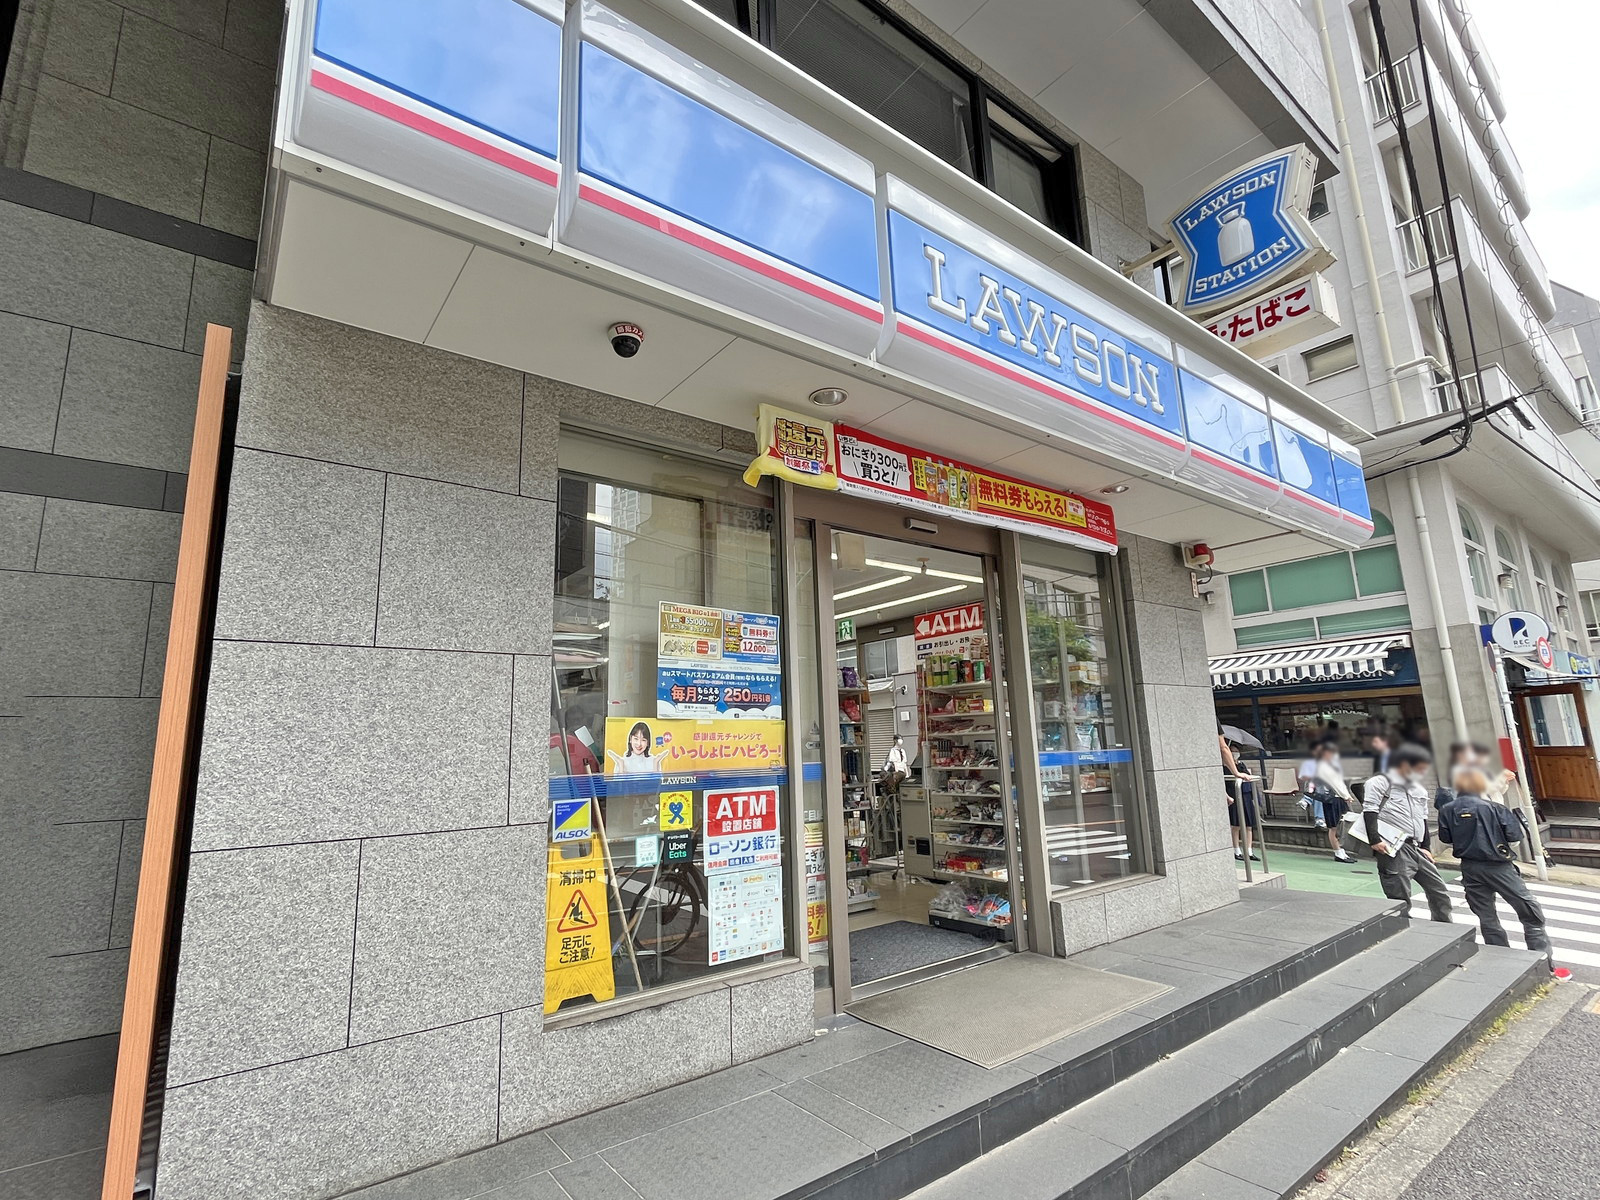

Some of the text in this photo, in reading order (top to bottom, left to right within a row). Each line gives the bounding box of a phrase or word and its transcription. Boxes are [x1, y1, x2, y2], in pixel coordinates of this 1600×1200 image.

[1183, 169, 1278, 232] LAWSON
[1194, 235, 1291, 294] STATION
[923, 243, 1165, 415] LAWSON
[979, 477, 1068, 518] 無料券もらえる!
[930, 606, 980, 636] ATM
[1513, 638, 1530, 646] REC
[671, 684, 697, 703] 毎月
[671, 743, 783, 759] いっしょにハピろー!
[661, 776, 697, 785] LAWSON
[715, 794, 767, 820] ATM
[555, 829, 589, 840] ALSOK
[668, 842, 687, 851] Uber
[668, 850, 687, 859] Eats
[708, 834, 777, 856] ローソン銀行
[559, 868, 597, 887] 清掃中
[561, 934, 592, 951] 足元に
[559, 946, 596, 964] ご注意!
